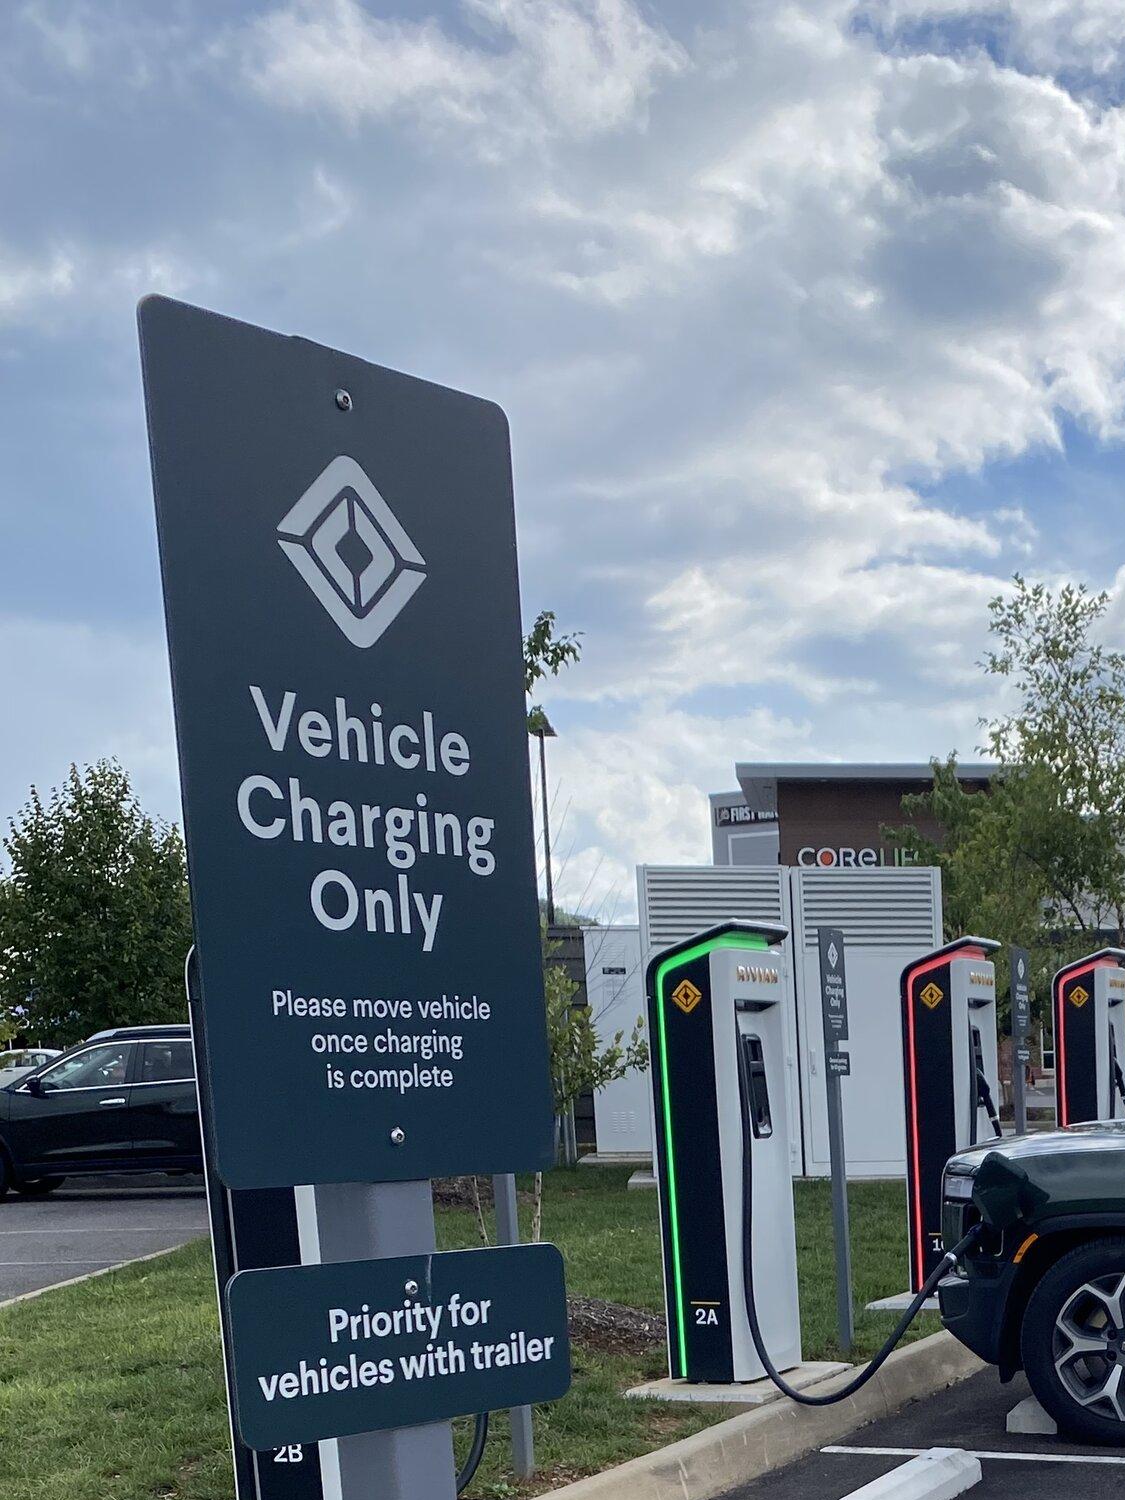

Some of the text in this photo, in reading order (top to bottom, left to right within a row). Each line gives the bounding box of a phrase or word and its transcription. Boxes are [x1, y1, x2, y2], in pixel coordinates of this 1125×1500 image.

[249, 685, 470, 776] Vehicle
[237, 774, 496, 876] Charging
[310, 869, 443, 952] Only
[736, 965, 779, 984] RIVIAN
[272, 990, 491, 1020] Please move vehicle
[311, 1028, 464, 1060] once charging
[326, 1063, 454, 1095] is complete
[932, 1238, 945, 1251] 1
[328, 1294, 491, 1343] Priority for
[695, 1308, 719, 1325] 2A
[258, 1331, 554, 1401] vehicles with trailer
[272, 1442, 304, 1462] 2B
